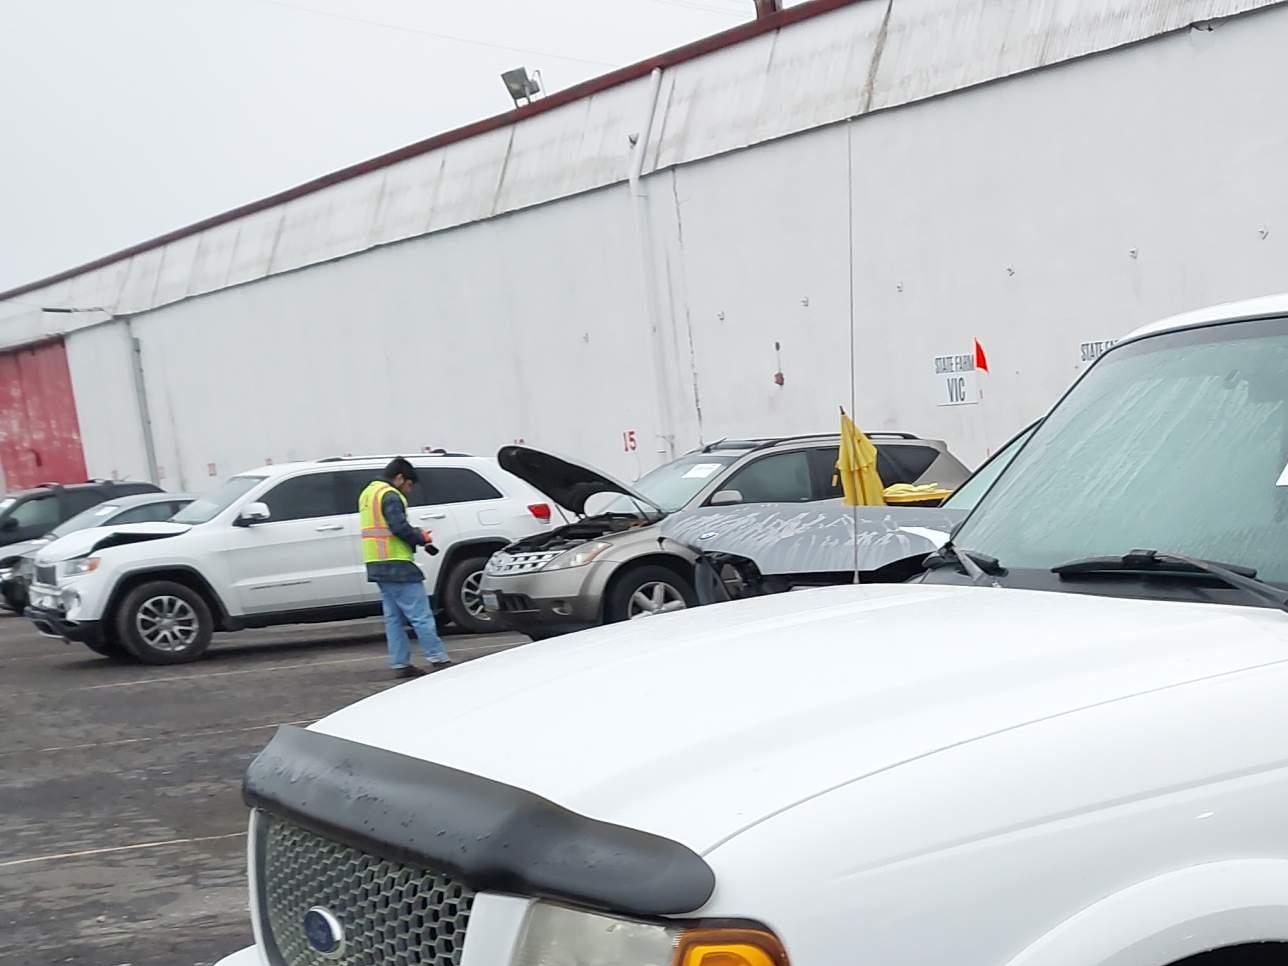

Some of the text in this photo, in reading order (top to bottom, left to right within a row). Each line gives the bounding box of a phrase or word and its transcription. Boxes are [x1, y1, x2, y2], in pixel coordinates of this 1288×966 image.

[934, 356, 954, 374] STATE
[947, 376, 966, 402] VIC
[623, 430, 637, 452] 15
